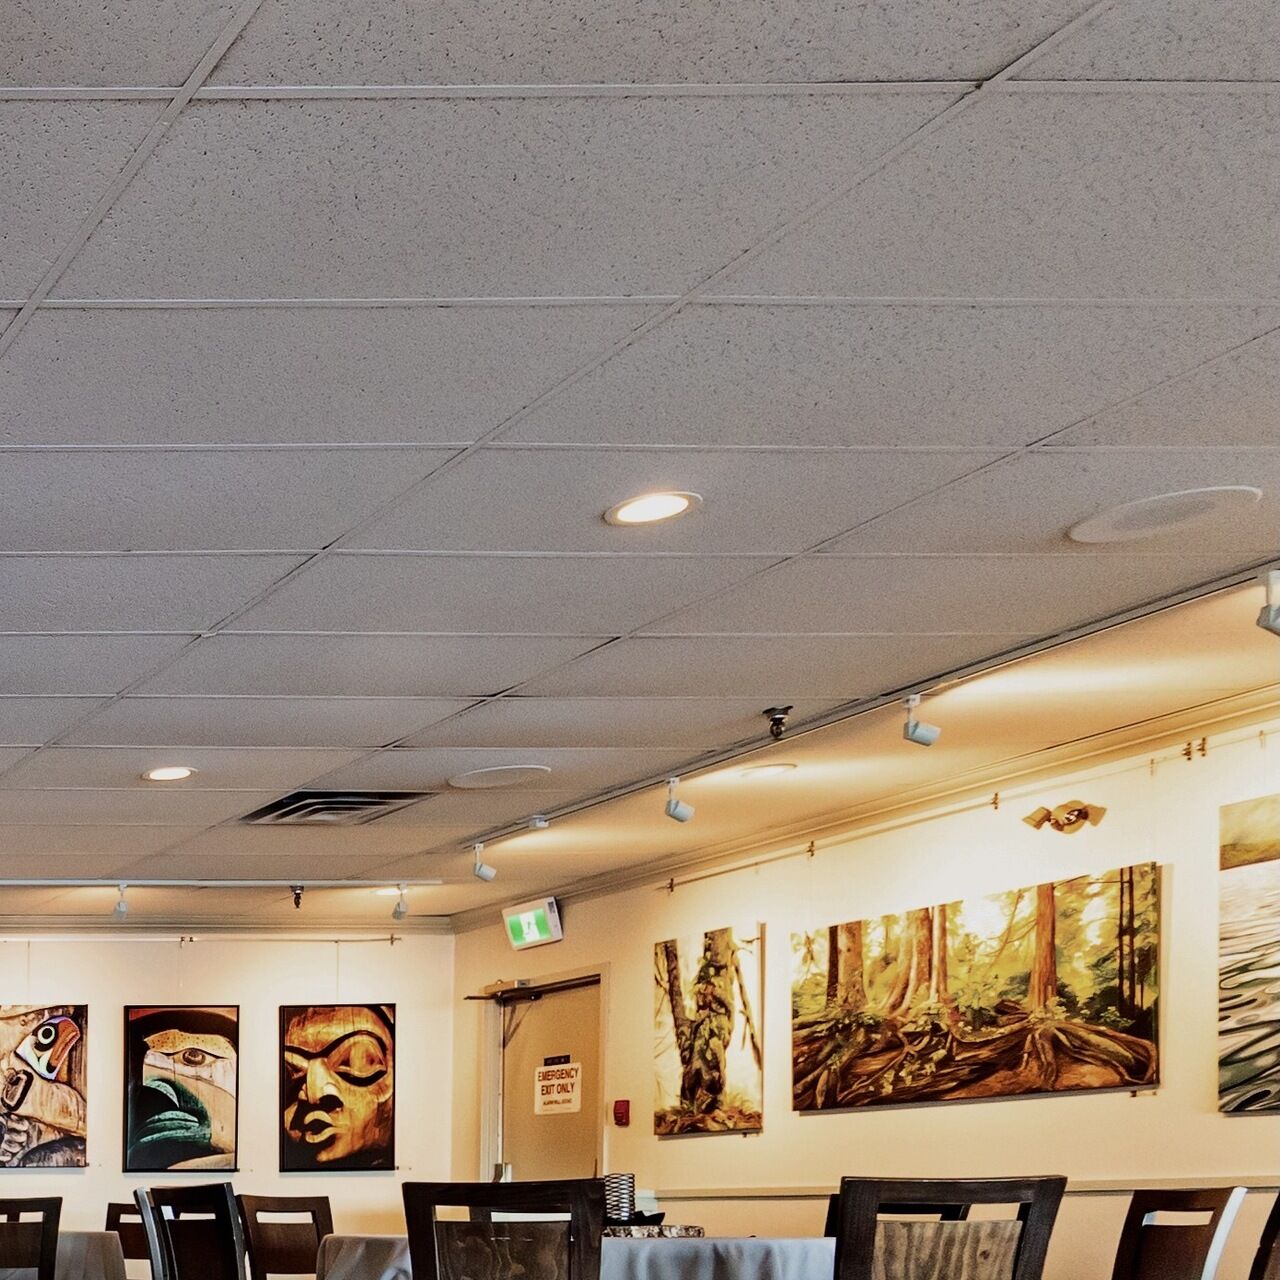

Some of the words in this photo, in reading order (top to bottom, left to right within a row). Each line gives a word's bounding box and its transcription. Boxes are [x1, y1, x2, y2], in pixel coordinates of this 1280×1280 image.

[538, 1068, 578, 1081] EMERGENCY
[541, 1084, 554, 1095] EXIT
[557, 1083, 575, 1094] ONLY
